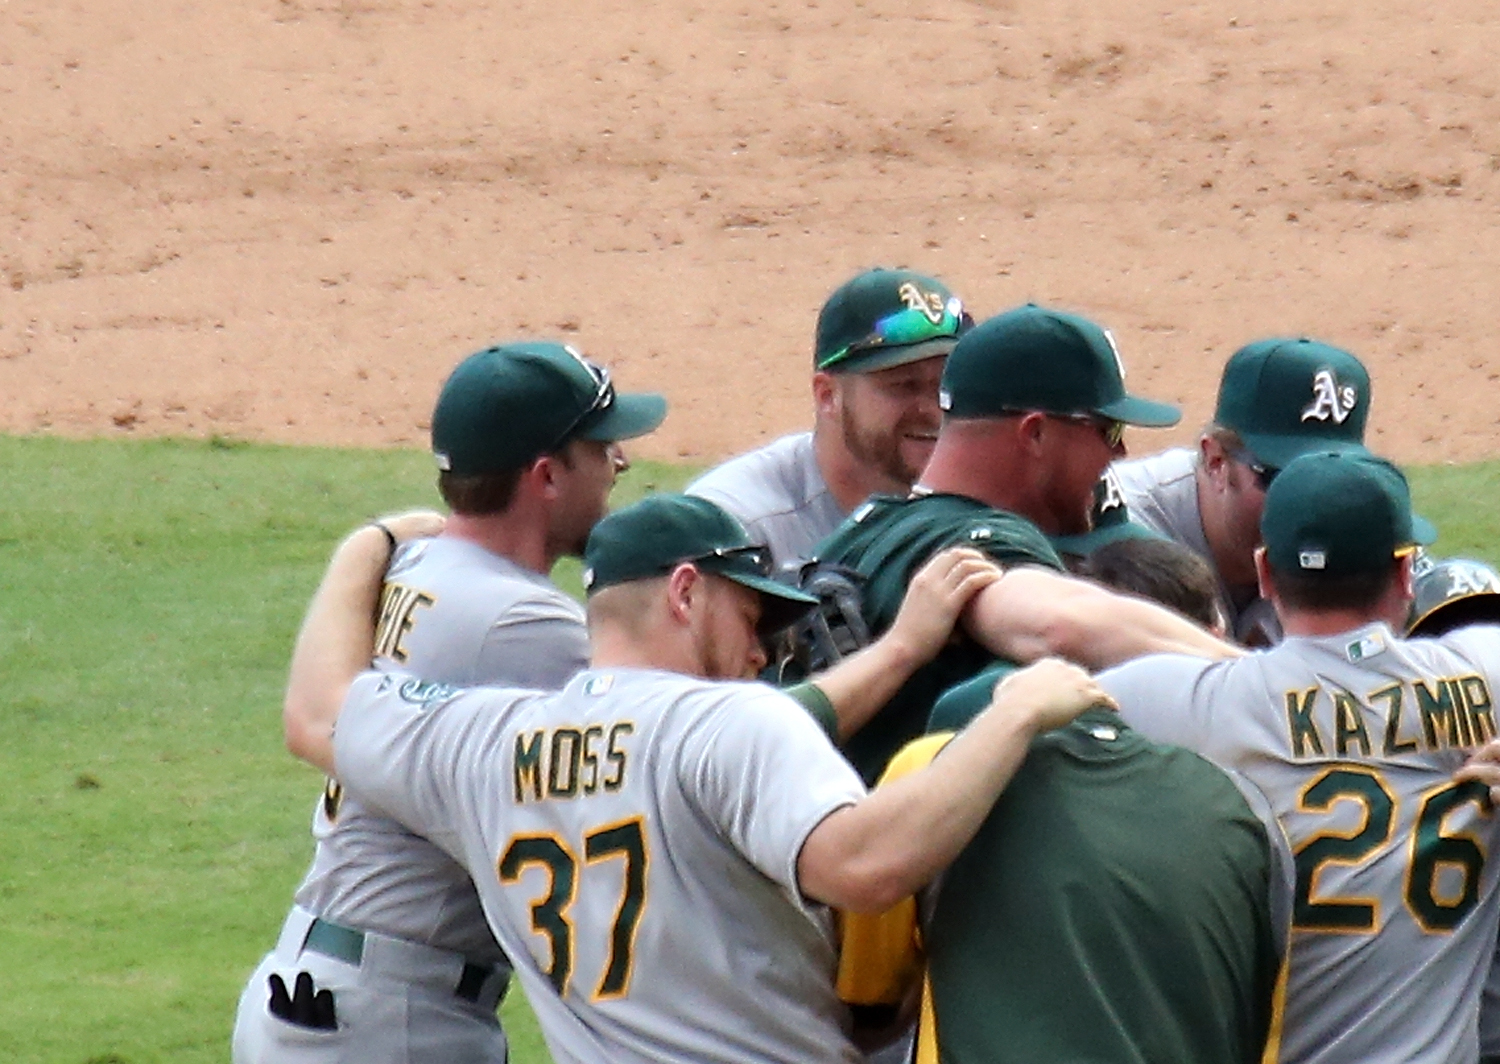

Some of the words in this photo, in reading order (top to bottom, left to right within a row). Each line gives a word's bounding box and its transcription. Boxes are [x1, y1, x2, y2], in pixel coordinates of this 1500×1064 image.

[1301, 368, 1355, 424] A's
[1285, 671, 1499, 760] KAZMIR
[513, 719, 635, 803] MOSS
[1290, 761, 1494, 936] 26
[494, 814, 651, 1003] 37
